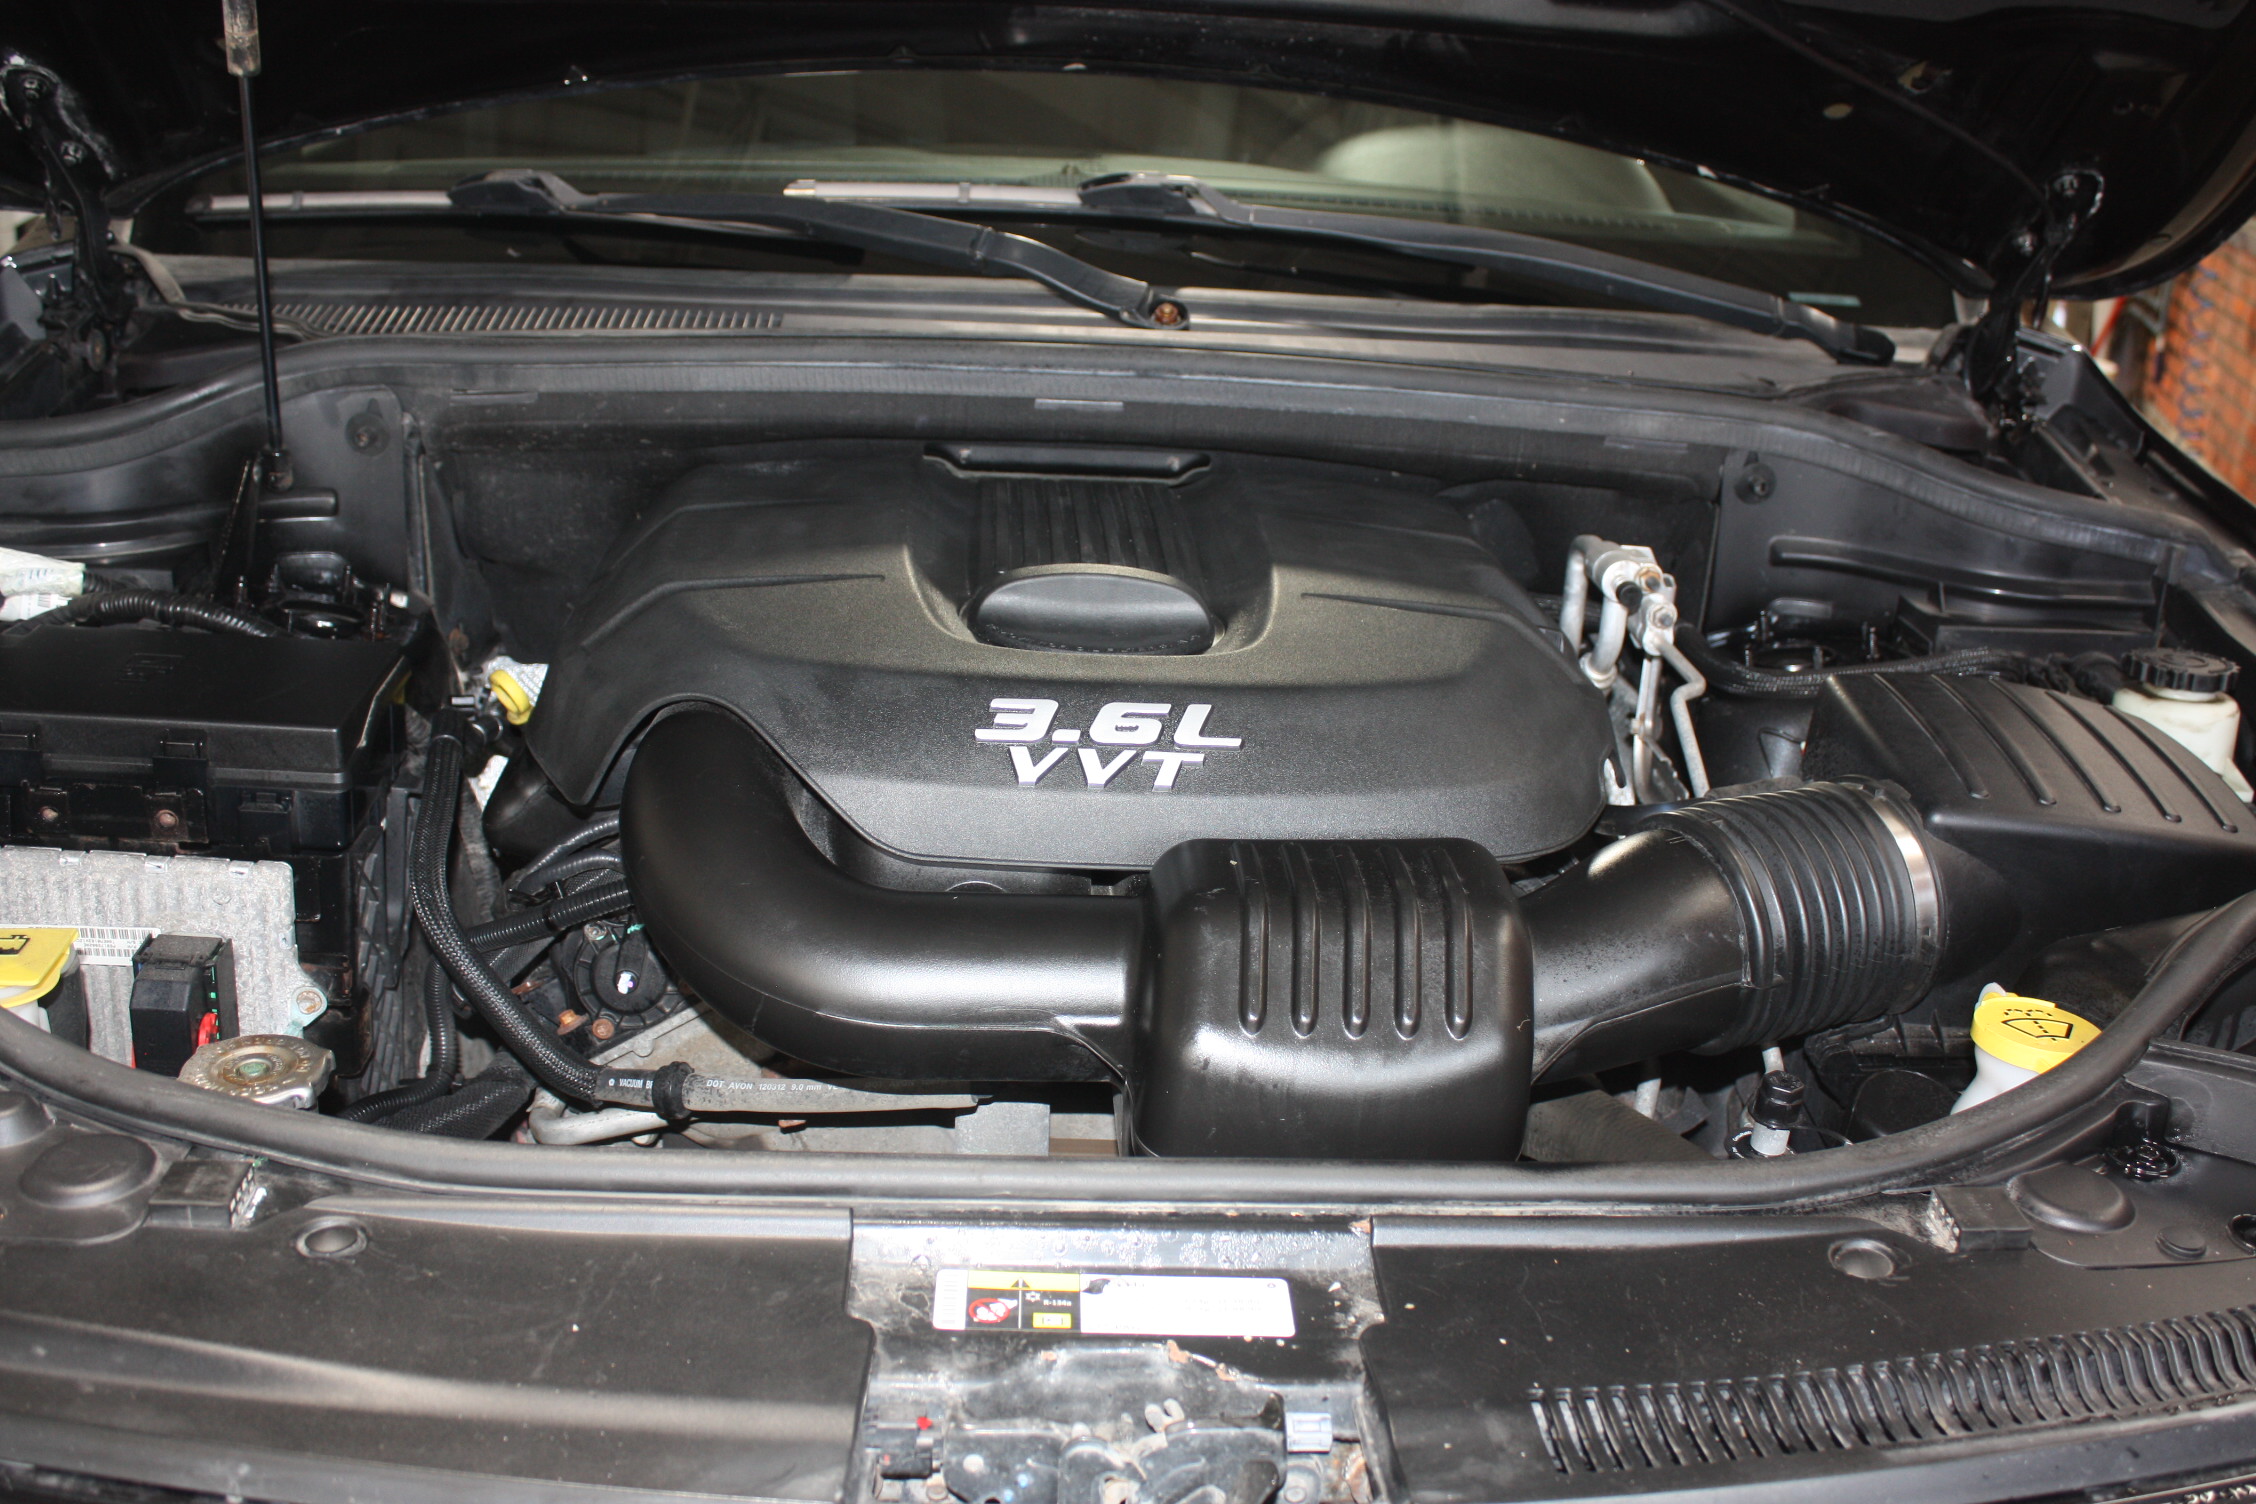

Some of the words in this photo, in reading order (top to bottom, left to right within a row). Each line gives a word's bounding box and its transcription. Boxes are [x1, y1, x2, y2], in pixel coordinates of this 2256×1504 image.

[974, 698, 1242, 749] 3.6L
[1009, 746, 1205, 792] VVT
[619, 1078, 644, 1089] VACUUM
[706, 1079, 725, 1088] DOT
[727, 1081, 754, 1090] AVON
[758, 1083, 786, 1091] 120312
[790, 1083, 804, 1091] 9.0
